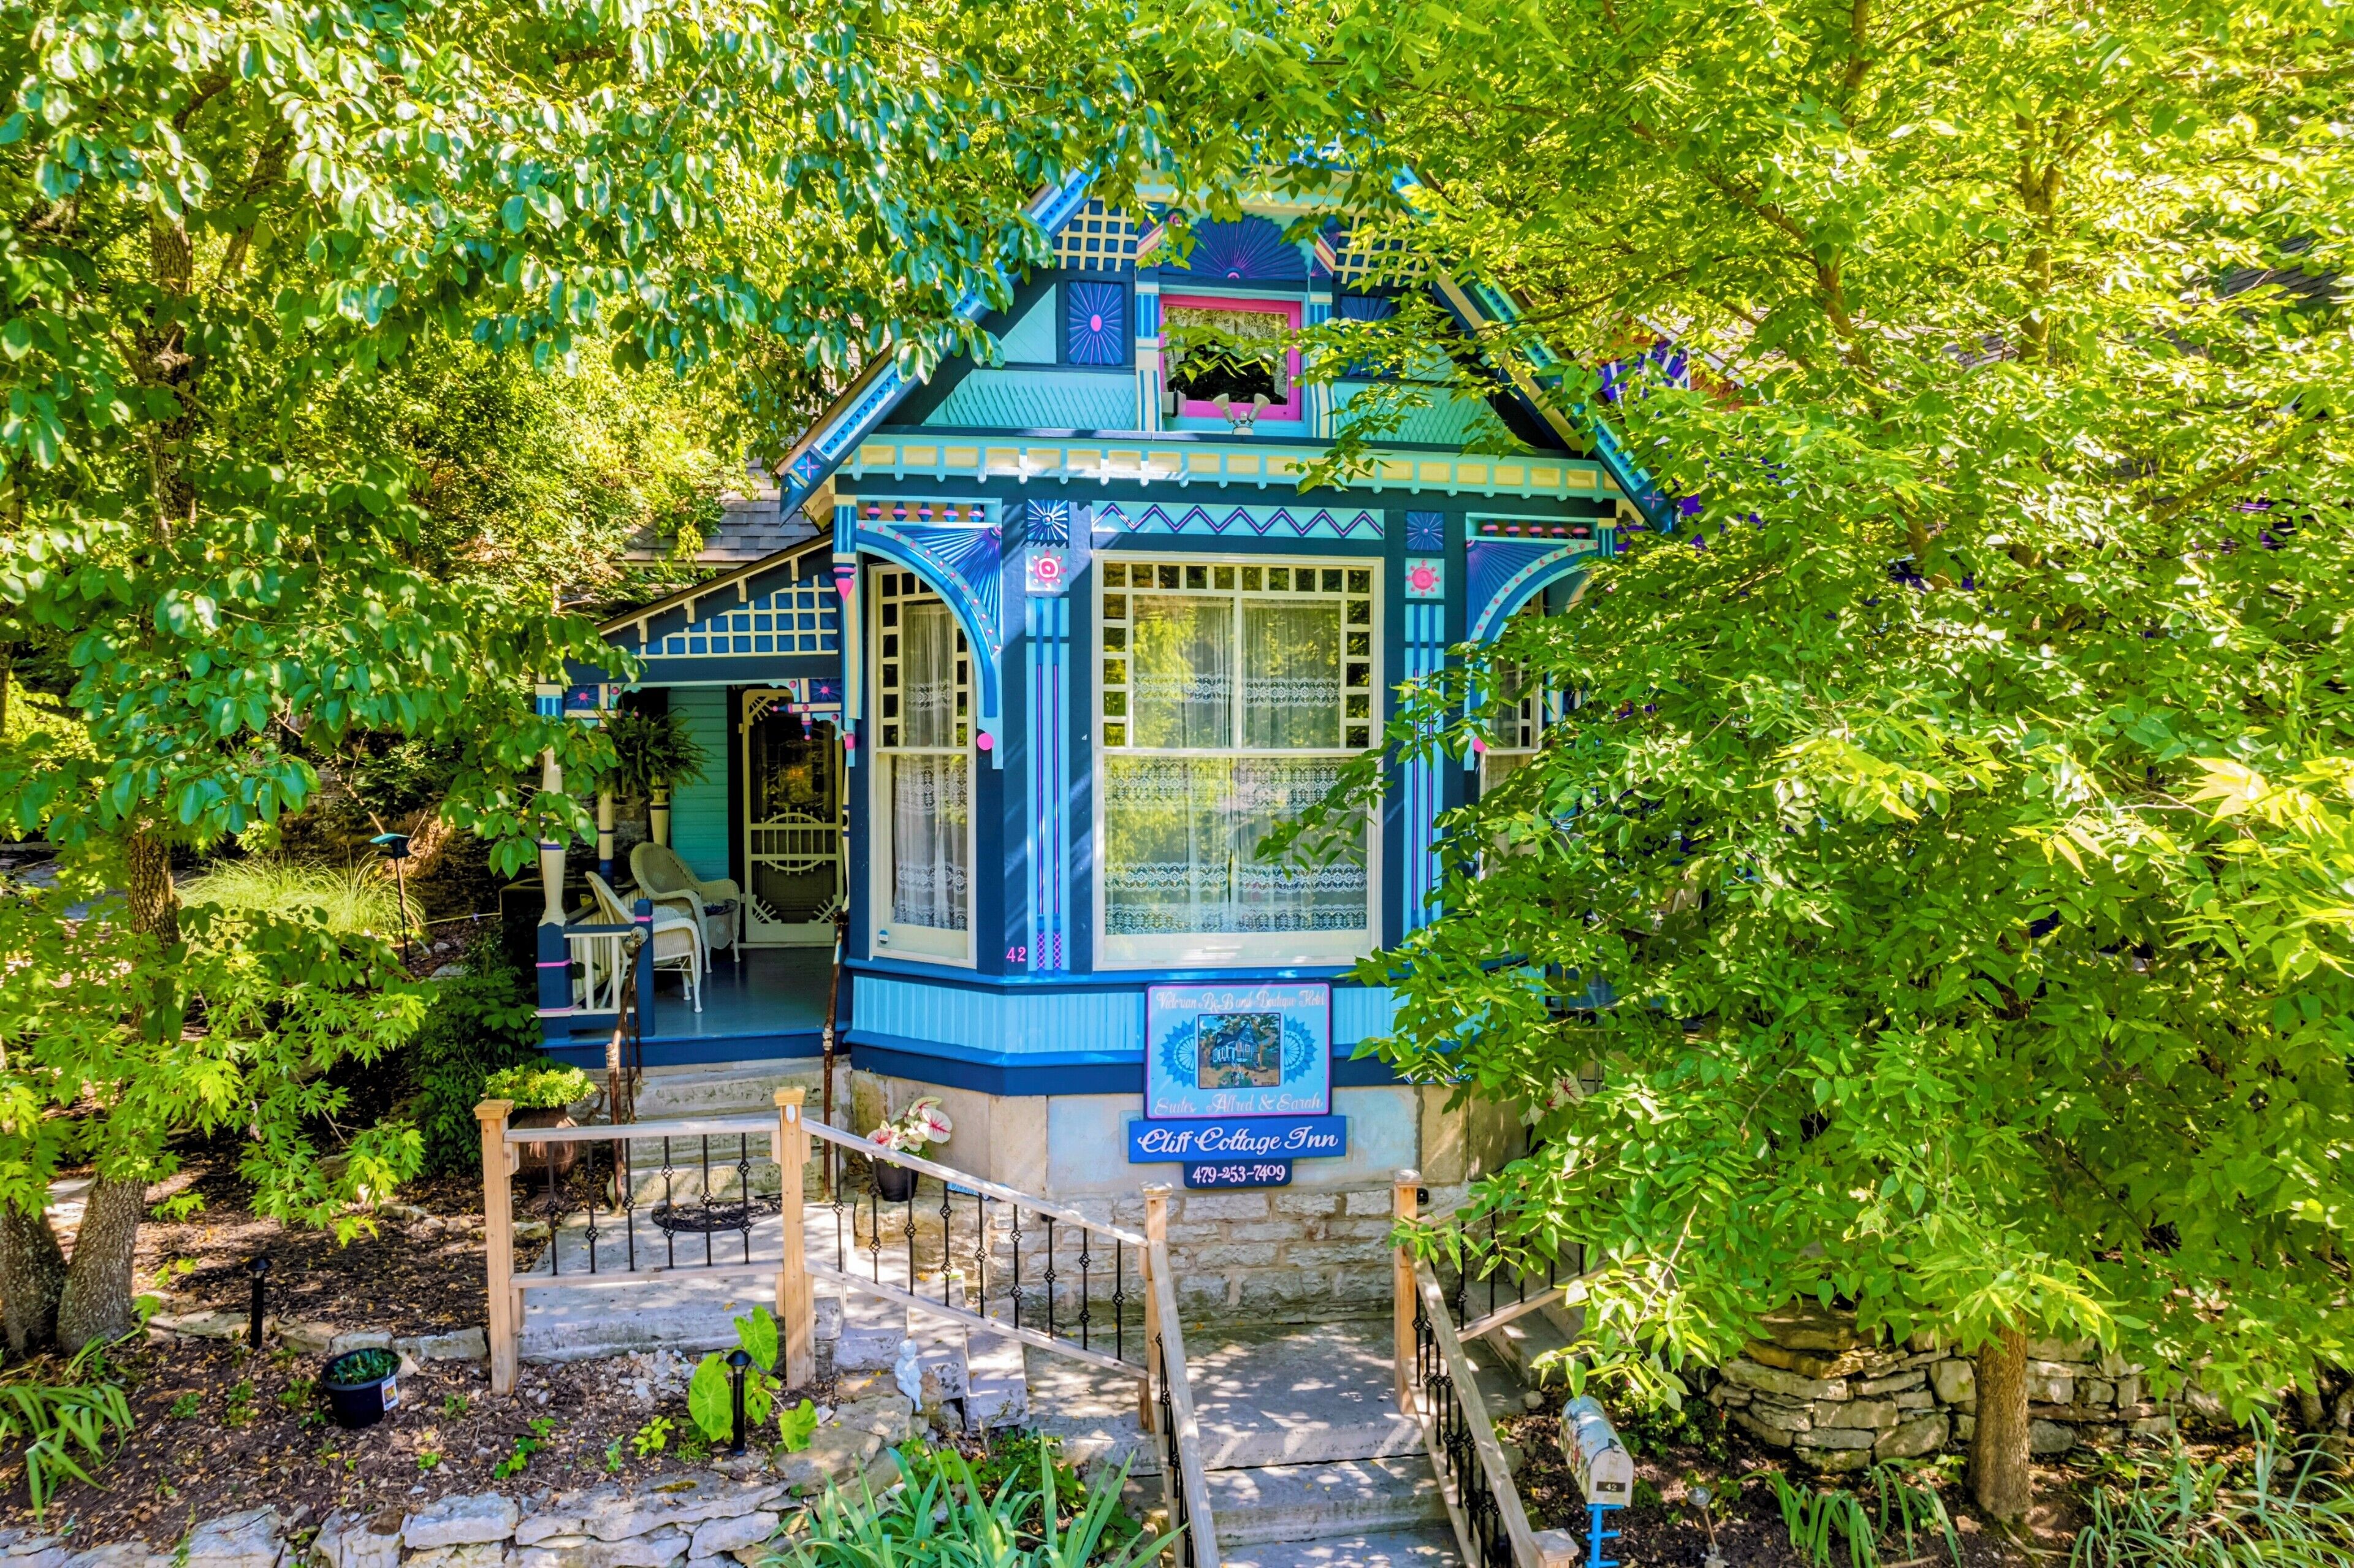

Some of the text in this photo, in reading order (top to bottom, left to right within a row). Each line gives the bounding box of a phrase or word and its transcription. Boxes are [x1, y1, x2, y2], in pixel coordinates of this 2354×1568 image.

[1006, 946, 1026, 962] 42
[1156, 992, 1197, 1009] Victorian
[1235, 991, 1254, 1008] and
[1256, 990, 1296, 1010] Boutique
[1299, 989, 1325, 1007] Hotel
[1154, 1092, 1323, 1115] Suites Alfred & Sarah
[1137, 1125, 1338, 1155] Cliff Cottage Inn
[1192, 1165, 1286, 1183] 479-253-7409
